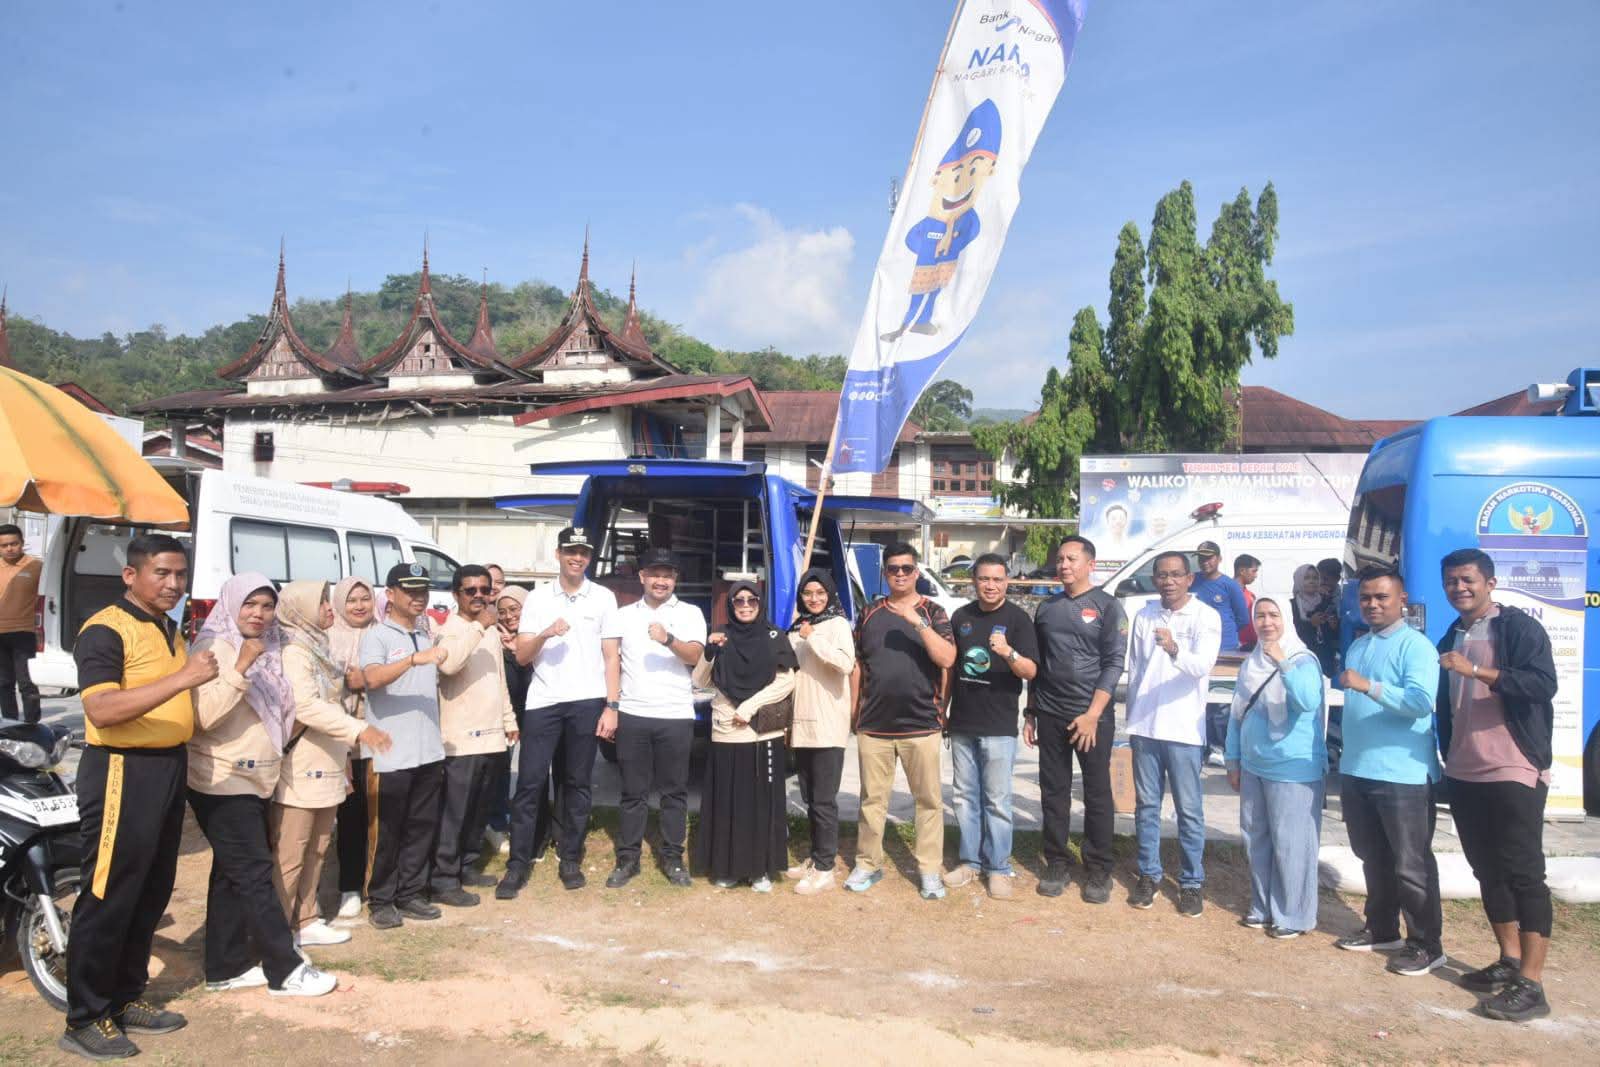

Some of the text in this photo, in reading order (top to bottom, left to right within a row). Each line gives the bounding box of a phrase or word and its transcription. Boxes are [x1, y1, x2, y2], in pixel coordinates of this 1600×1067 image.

[979, 11, 1010, 25] Bank
[1018, 25, 1064, 45] Nagari
[1127, 475, 1201, 489] WALIKOTA
[1208, 475, 1315, 489] SAWAHLUNTO
[1480, 486, 1583, 528] BADAN NARKOTIKA NASIONAL
[1226, 530, 1347, 540] DINAS KESEHATAN PENGENDA
